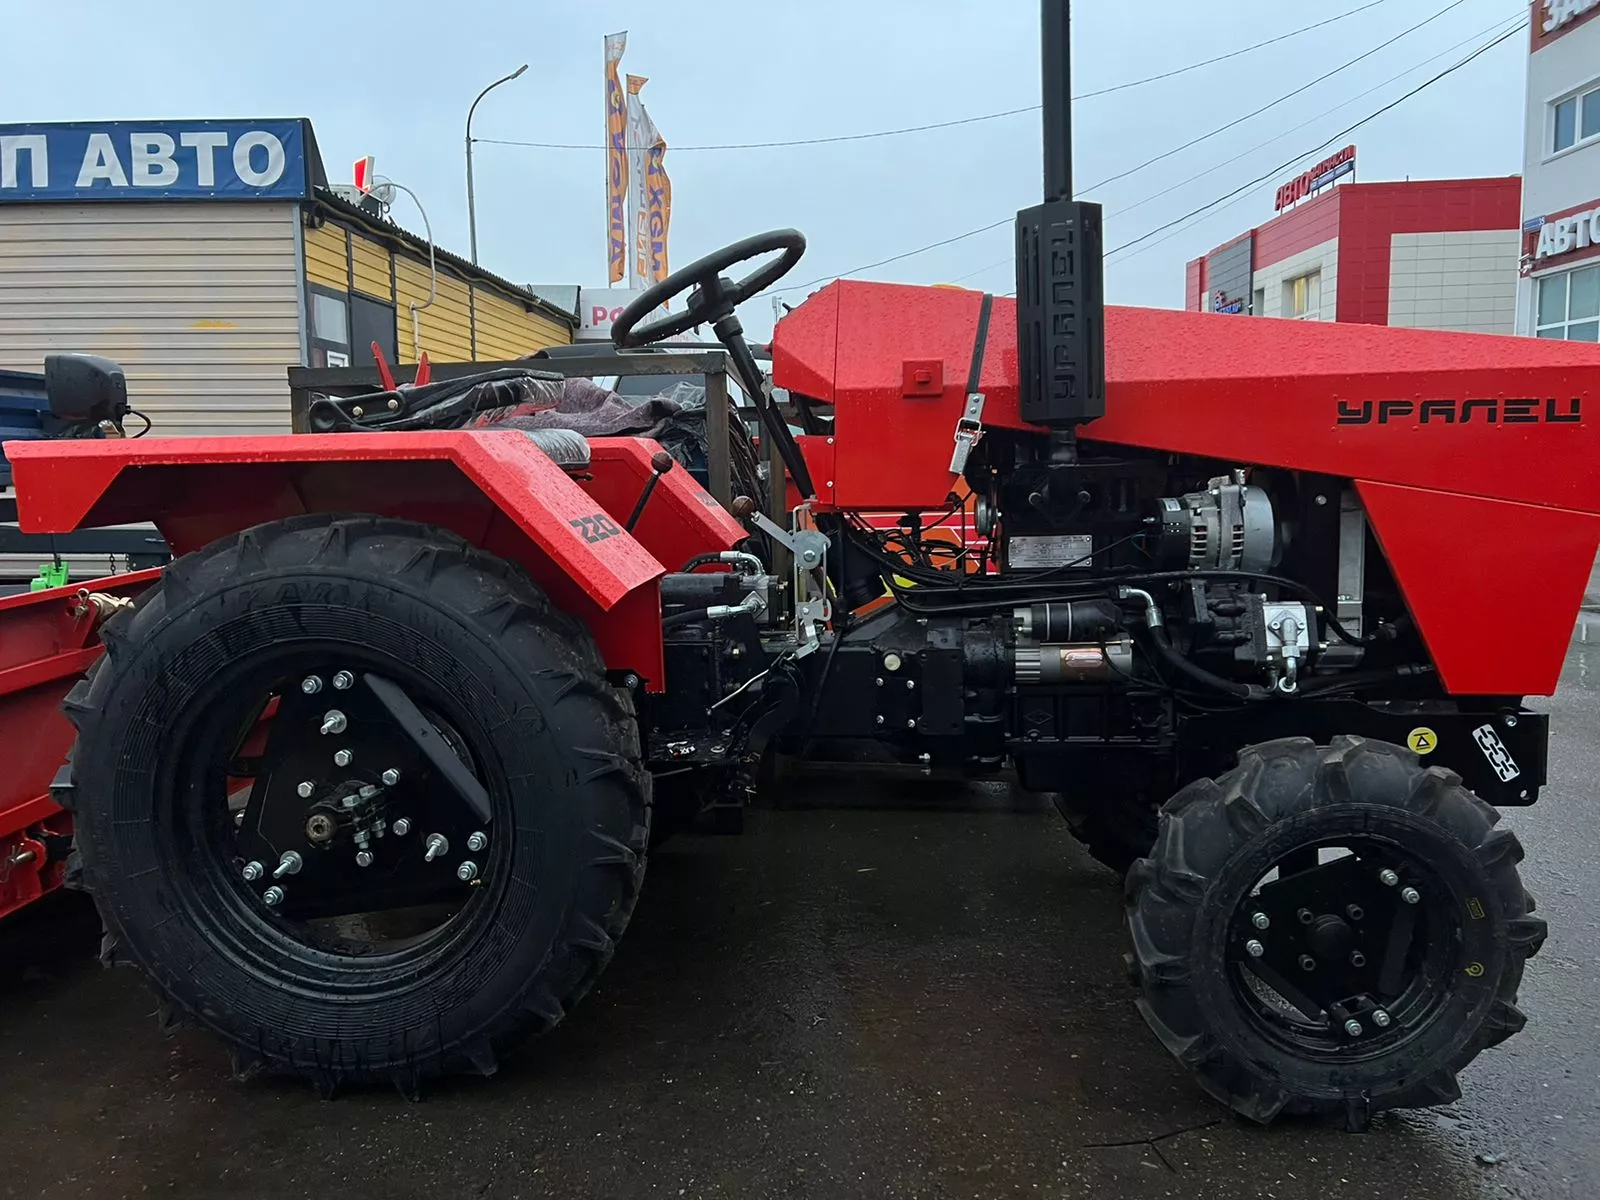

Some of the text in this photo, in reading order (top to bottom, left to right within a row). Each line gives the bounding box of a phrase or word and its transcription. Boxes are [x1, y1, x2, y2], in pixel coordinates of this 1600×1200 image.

[74, 130, 285, 188] АВТО
[649, 187, 665, 283] XGM
[1051, 219, 1076, 398] УРАЛЕЦ
[1337, 398, 1581, 425] УРАЛЕЦ
[570, 513, 621, 544] 220
